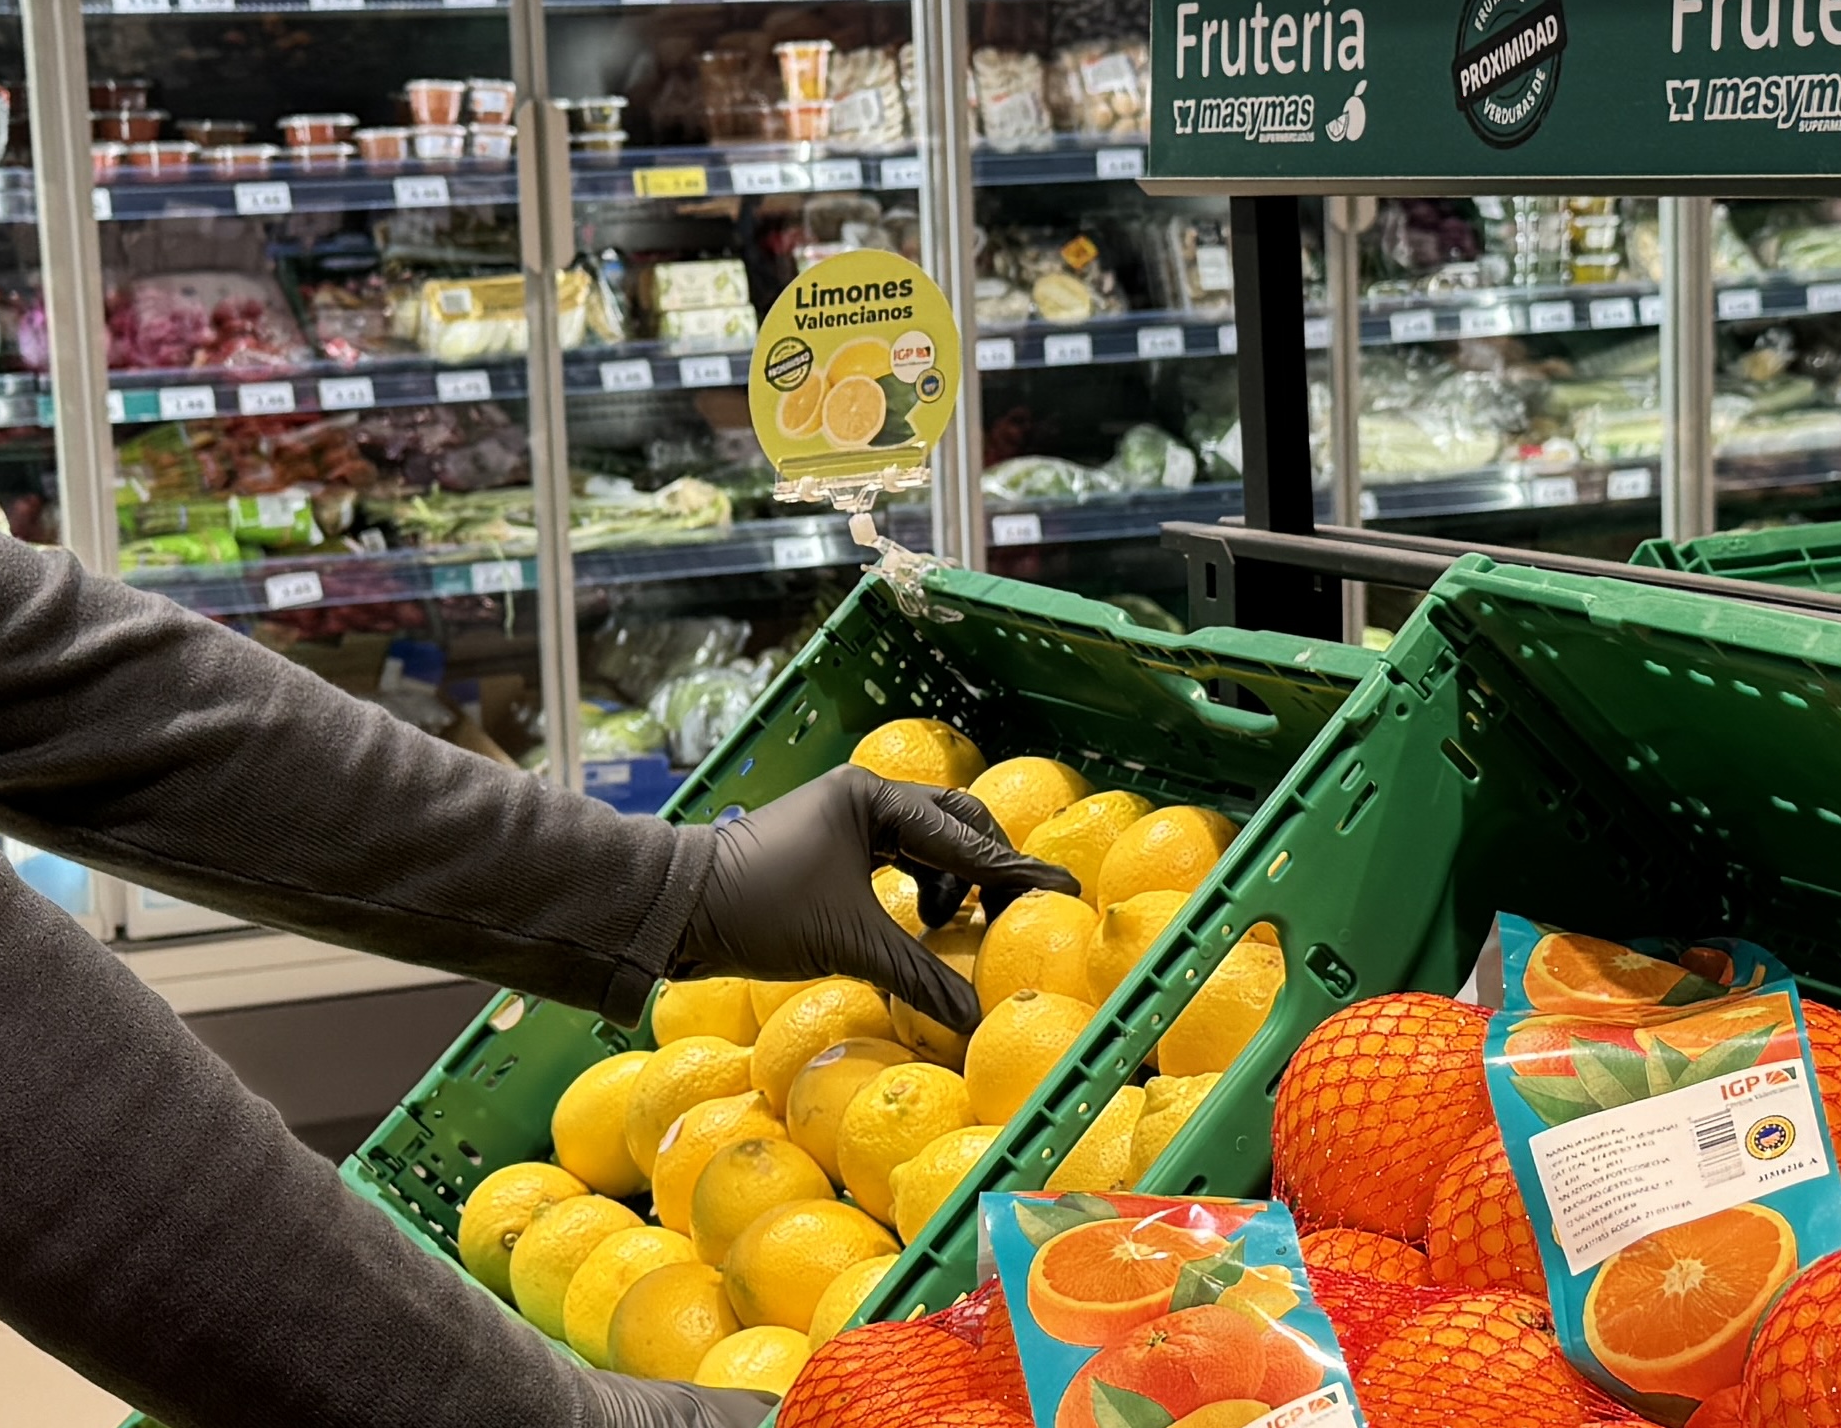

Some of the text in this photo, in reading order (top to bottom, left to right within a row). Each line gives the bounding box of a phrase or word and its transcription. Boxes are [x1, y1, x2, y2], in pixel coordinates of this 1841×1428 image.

[1460, 14, 1559, 98] PROXIMIDAD
[1482, 67, 1547, 126] VERDURAS DE
[1198, 94, 1315, 141] masymas
[795, 278, 914, 310] Limones
[794, 304, 914, 331] Valencianos
[1720, 1075, 1760, 1101] IGP
[1810, 1157, 1818, 1165] A
